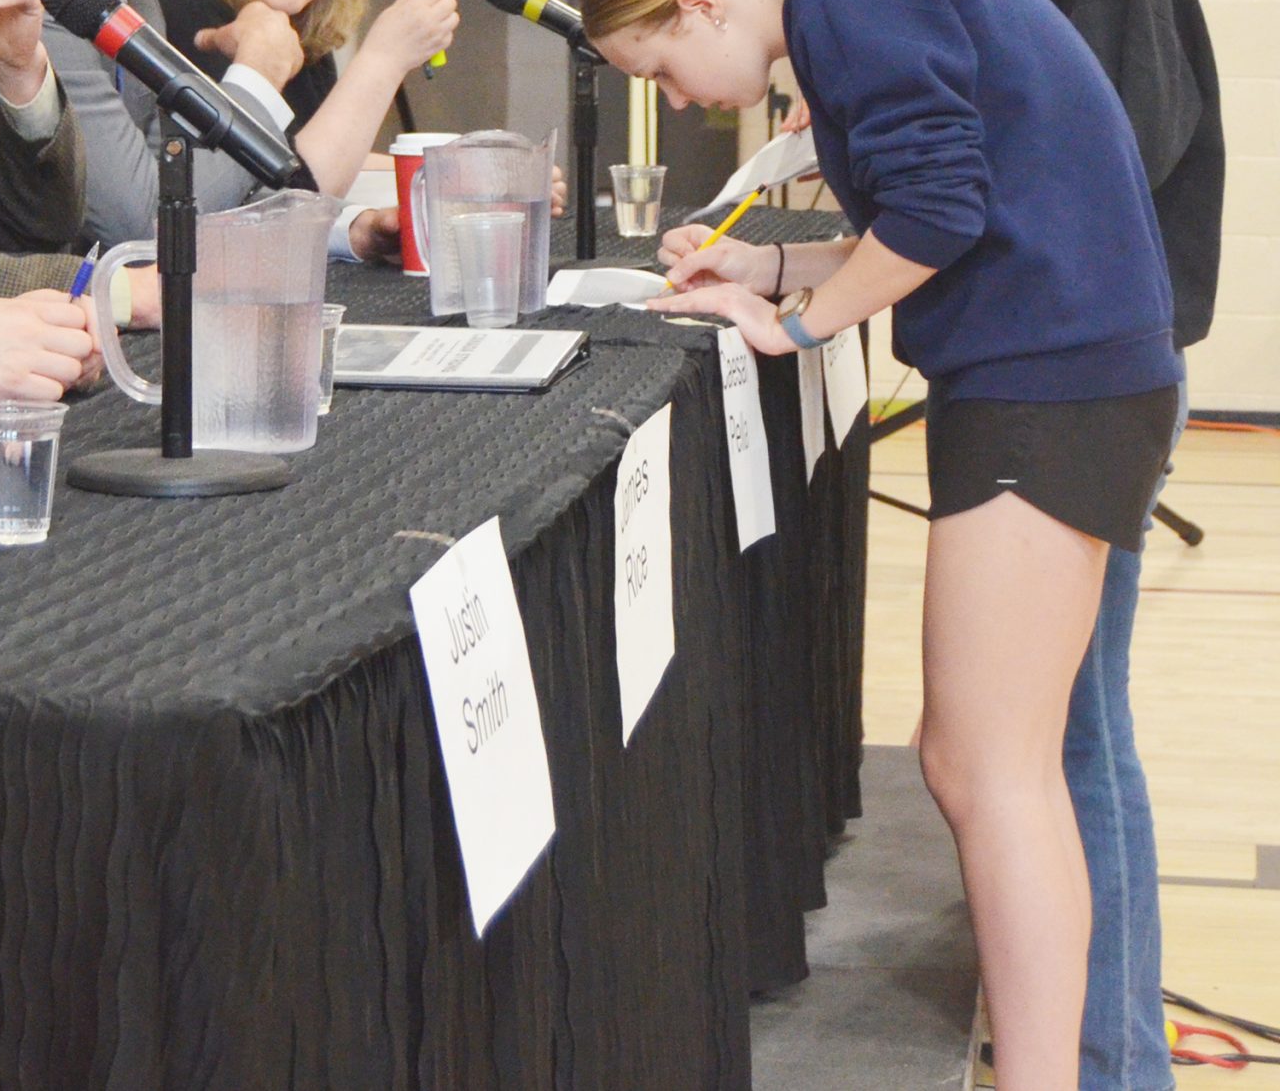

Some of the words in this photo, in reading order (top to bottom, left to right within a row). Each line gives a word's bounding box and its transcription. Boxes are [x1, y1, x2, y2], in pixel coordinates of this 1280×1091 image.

[621, 459, 649, 534] James
[625, 544, 648, 607] Rice
[444, 584, 490, 665] Justin
[462, 669, 508, 755] Smith
